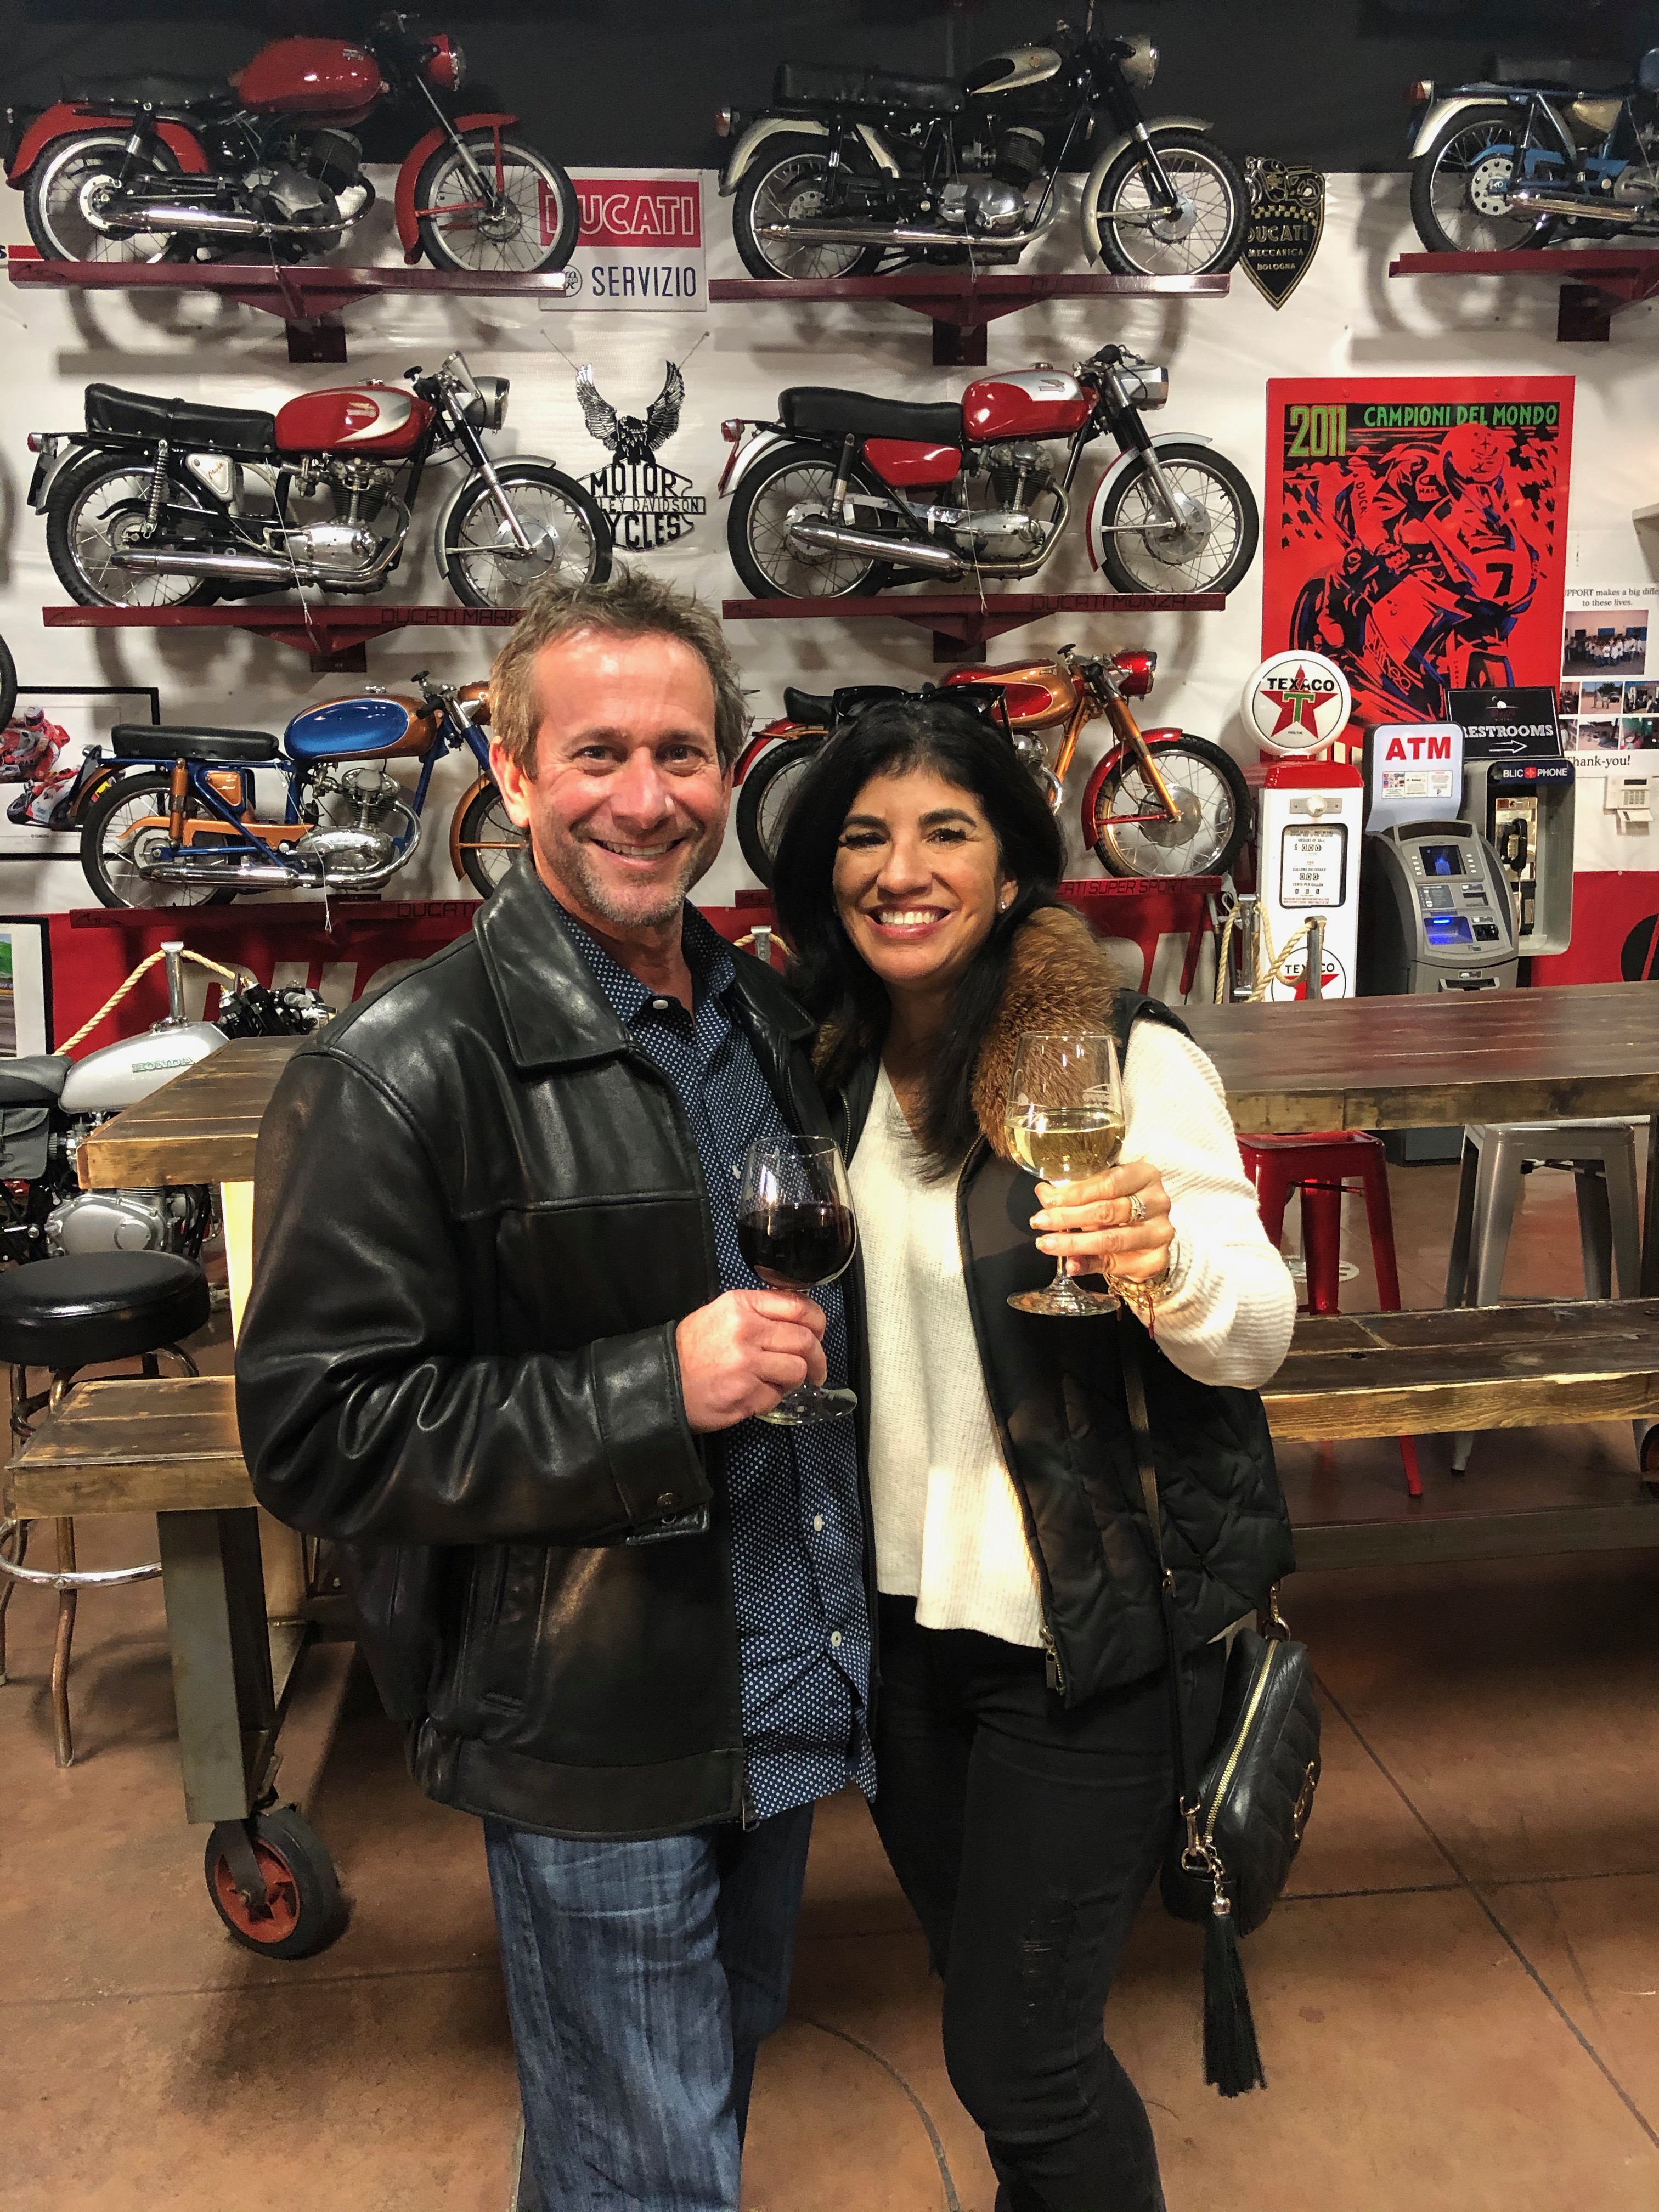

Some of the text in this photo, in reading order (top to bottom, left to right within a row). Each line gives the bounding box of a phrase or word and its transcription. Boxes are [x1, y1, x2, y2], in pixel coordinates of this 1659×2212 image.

[1248, 249, 1304, 257] MECCANICA
[591, 266, 696, 296] SERVIZIO
[1287, 404, 1558, 456] 2011 CAMPIONI DEL MONDO
[590, 461, 678, 498] MOTOR
[633, 498, 698, 512] DAVIDSON
[1485, 562, 1513, 599] 7
[1628, 588, 1640, 596] big
[1267, 678, 1334, 691] TEXACO
[1385, 737, 1451, 761] ATM
[1537, 768, 1568, 777] PHONE
[1088, 880, 1136, 894] SUPER
[1284, 963, 1335, 974] TECO
[131, 1056, 195, 1073] HONDA
